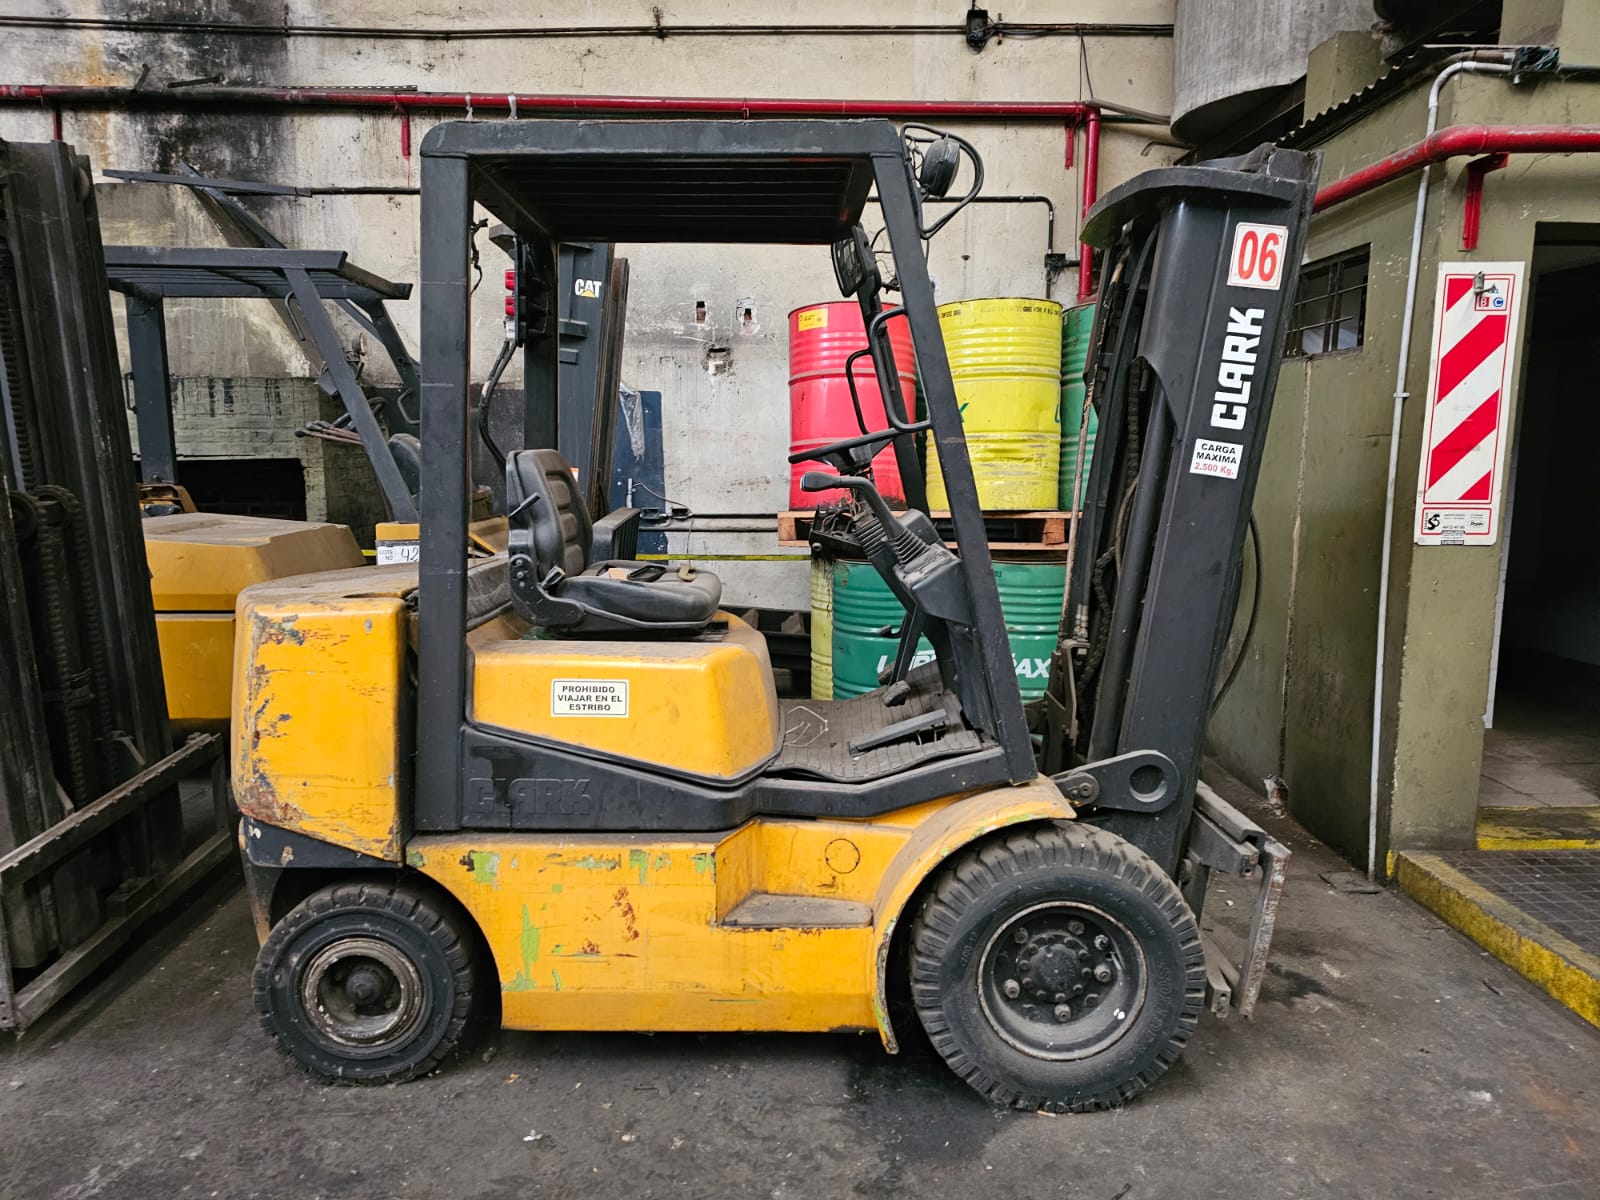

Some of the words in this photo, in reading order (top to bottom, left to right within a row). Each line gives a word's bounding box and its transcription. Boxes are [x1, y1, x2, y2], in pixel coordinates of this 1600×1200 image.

[1238, 230, 1279, 283] 06
[575, 278, 602, 298] CAT
[1210, 306, 1265, 431] CLARK
[1201, 443, 1236, 454] CARGA
[1196, 452, 1237, 465] MAXIMA
[1194, 462, 1218, 472] 2.500
[1220, 465, 1234, 476] Kg.
[562, 685, 616, 693] PROHIBIDO
[557, 694, 592, 702] VIAJAR
[611, 695, 623, 703] EL
[569, 703, 611, 711] ESTRIBO
